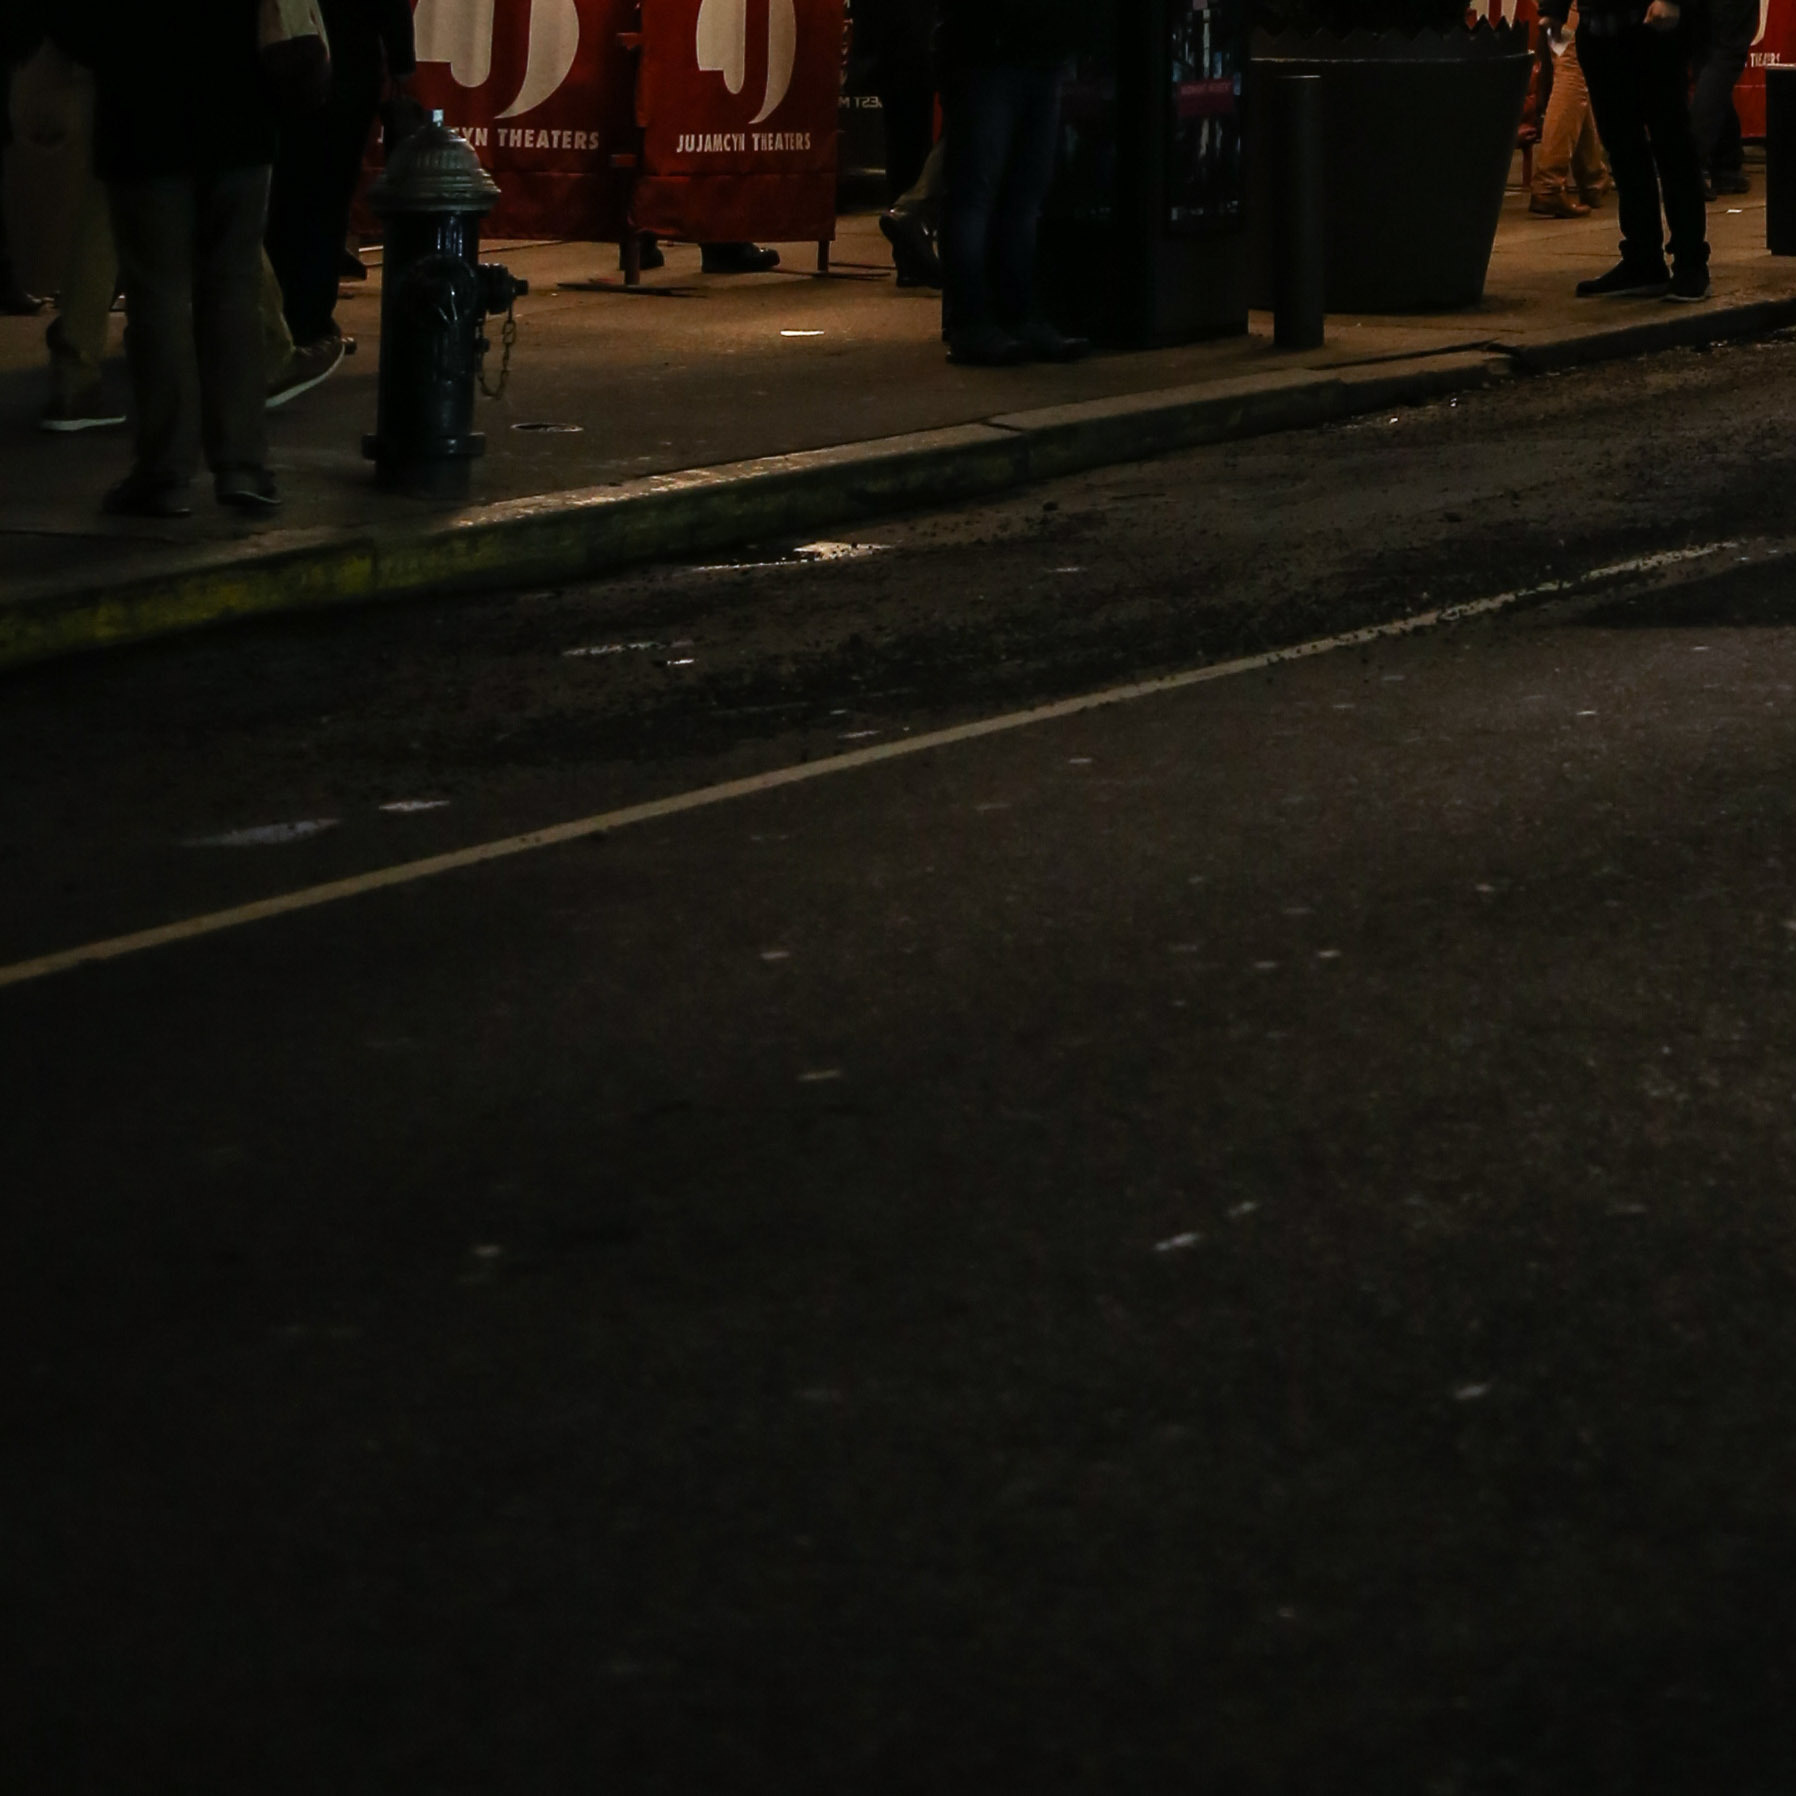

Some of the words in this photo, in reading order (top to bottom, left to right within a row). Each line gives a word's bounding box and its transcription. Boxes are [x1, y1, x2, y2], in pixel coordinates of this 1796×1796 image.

[498, 128, 600, 151] THEATERS
[676, 133, 746, 153] JUJAMCYN
[753, 132, 812, 151] THEATERS
